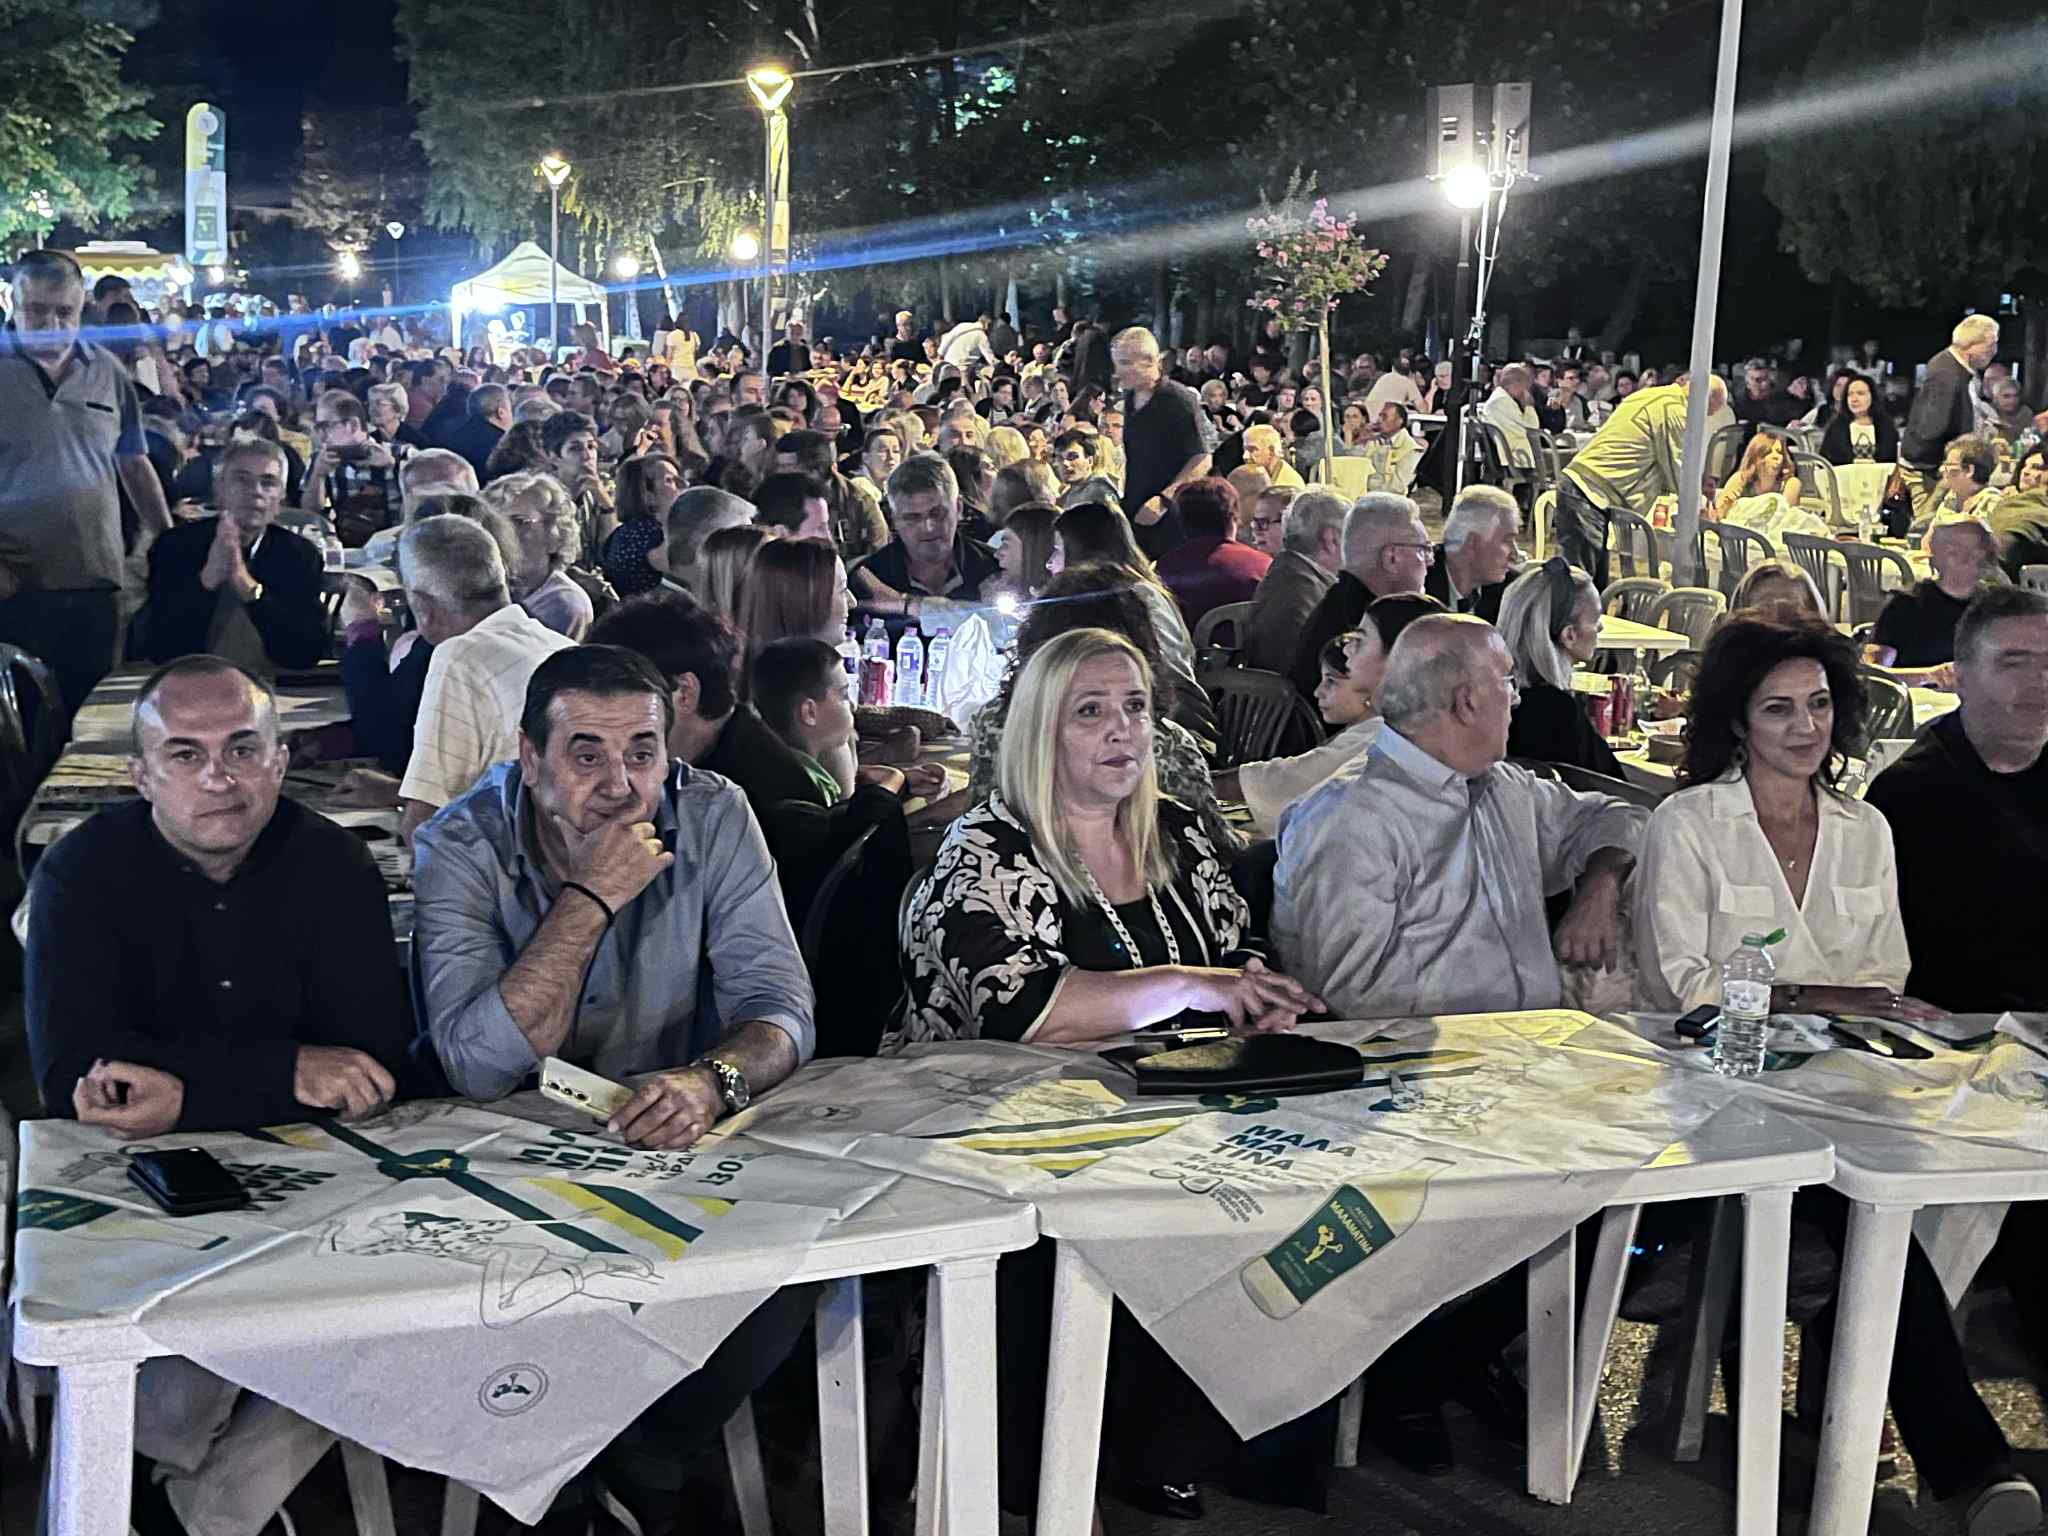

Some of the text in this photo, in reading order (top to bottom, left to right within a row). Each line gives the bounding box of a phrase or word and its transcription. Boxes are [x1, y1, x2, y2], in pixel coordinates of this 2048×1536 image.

[1225, 1134, 1286, 1155] ΜΑ
[1241, 1125, 1357, 1157] ΜΑΛΑ
[1211, 1143, 1295, 1170] ΤΙΝΑ
